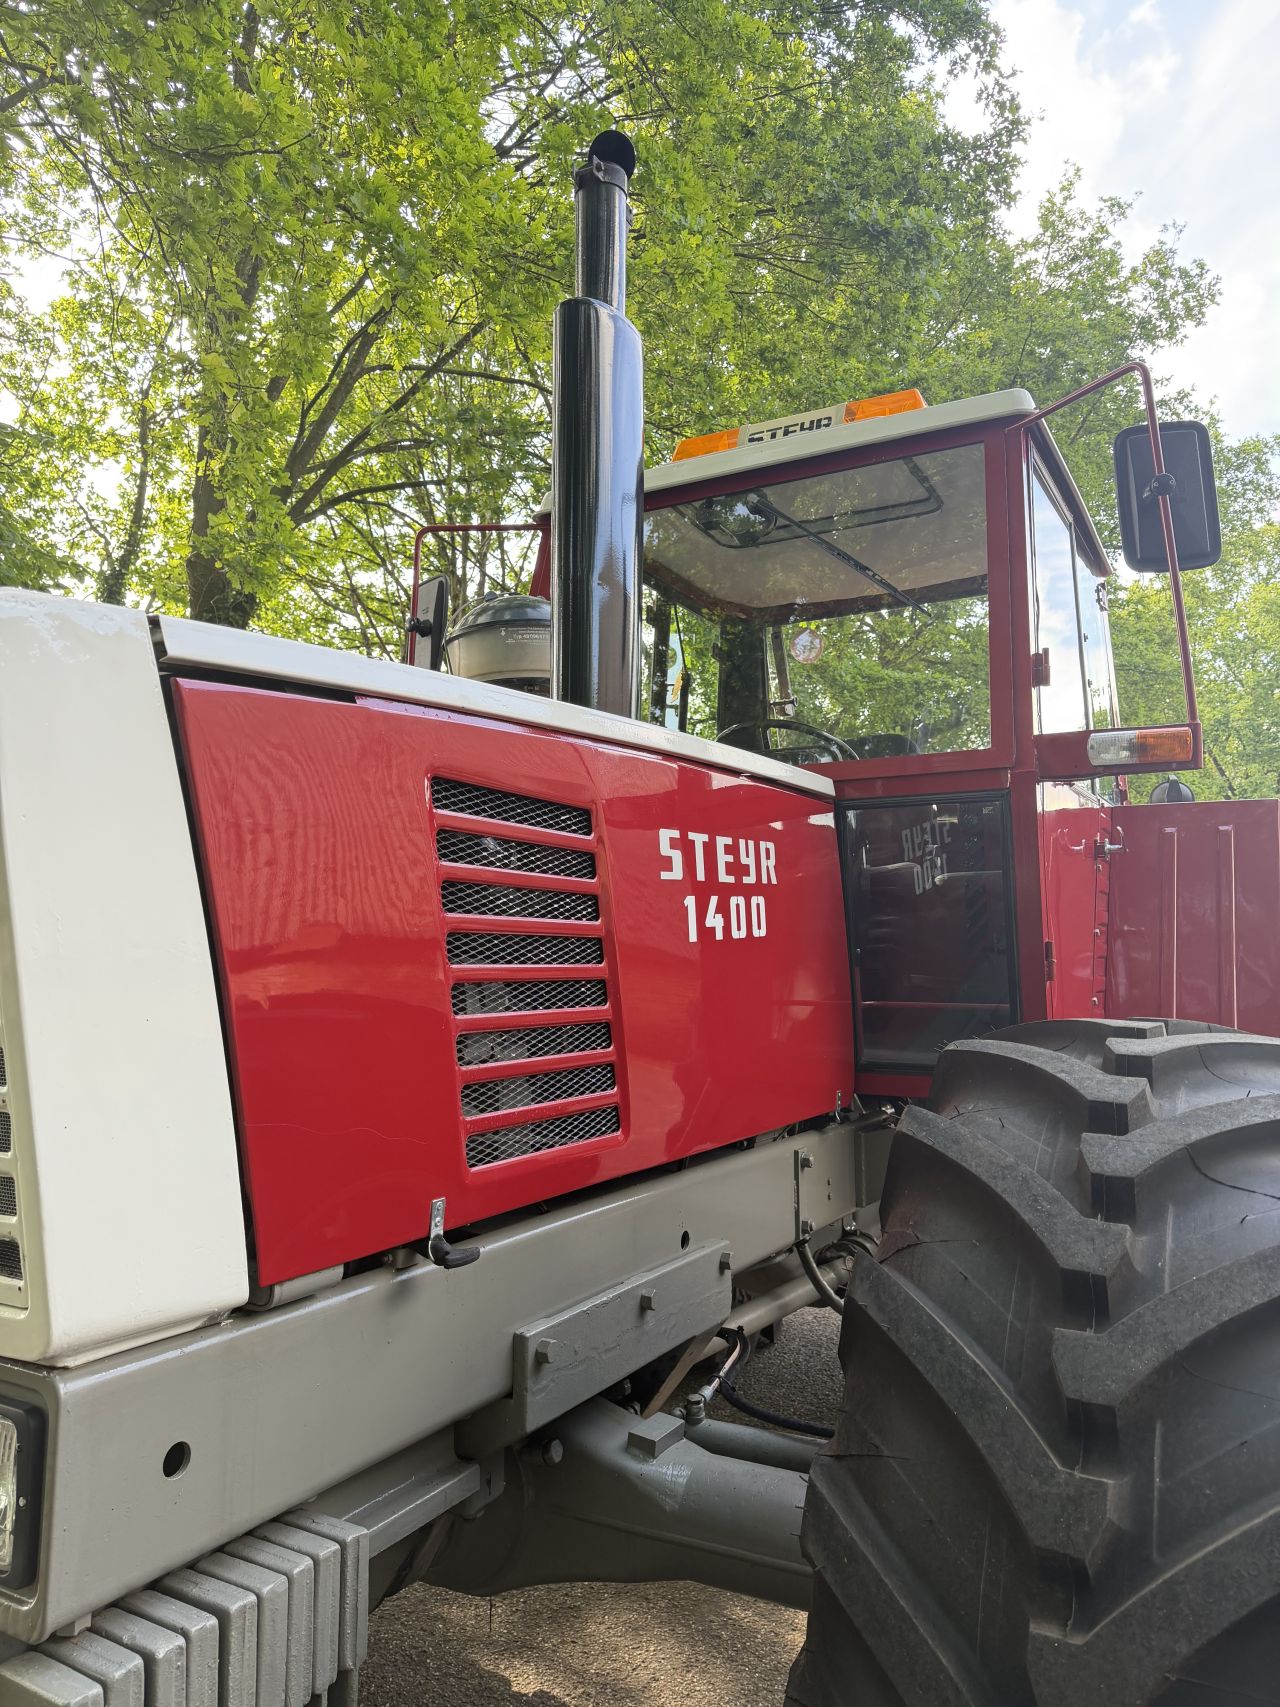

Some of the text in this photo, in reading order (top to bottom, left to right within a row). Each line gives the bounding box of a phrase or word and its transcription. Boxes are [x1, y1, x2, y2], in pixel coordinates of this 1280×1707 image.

[747, 416, 833, 443] STEYR
[658, 828, 777, 885] STEYR
[683, 895, 767, 942] 1400
